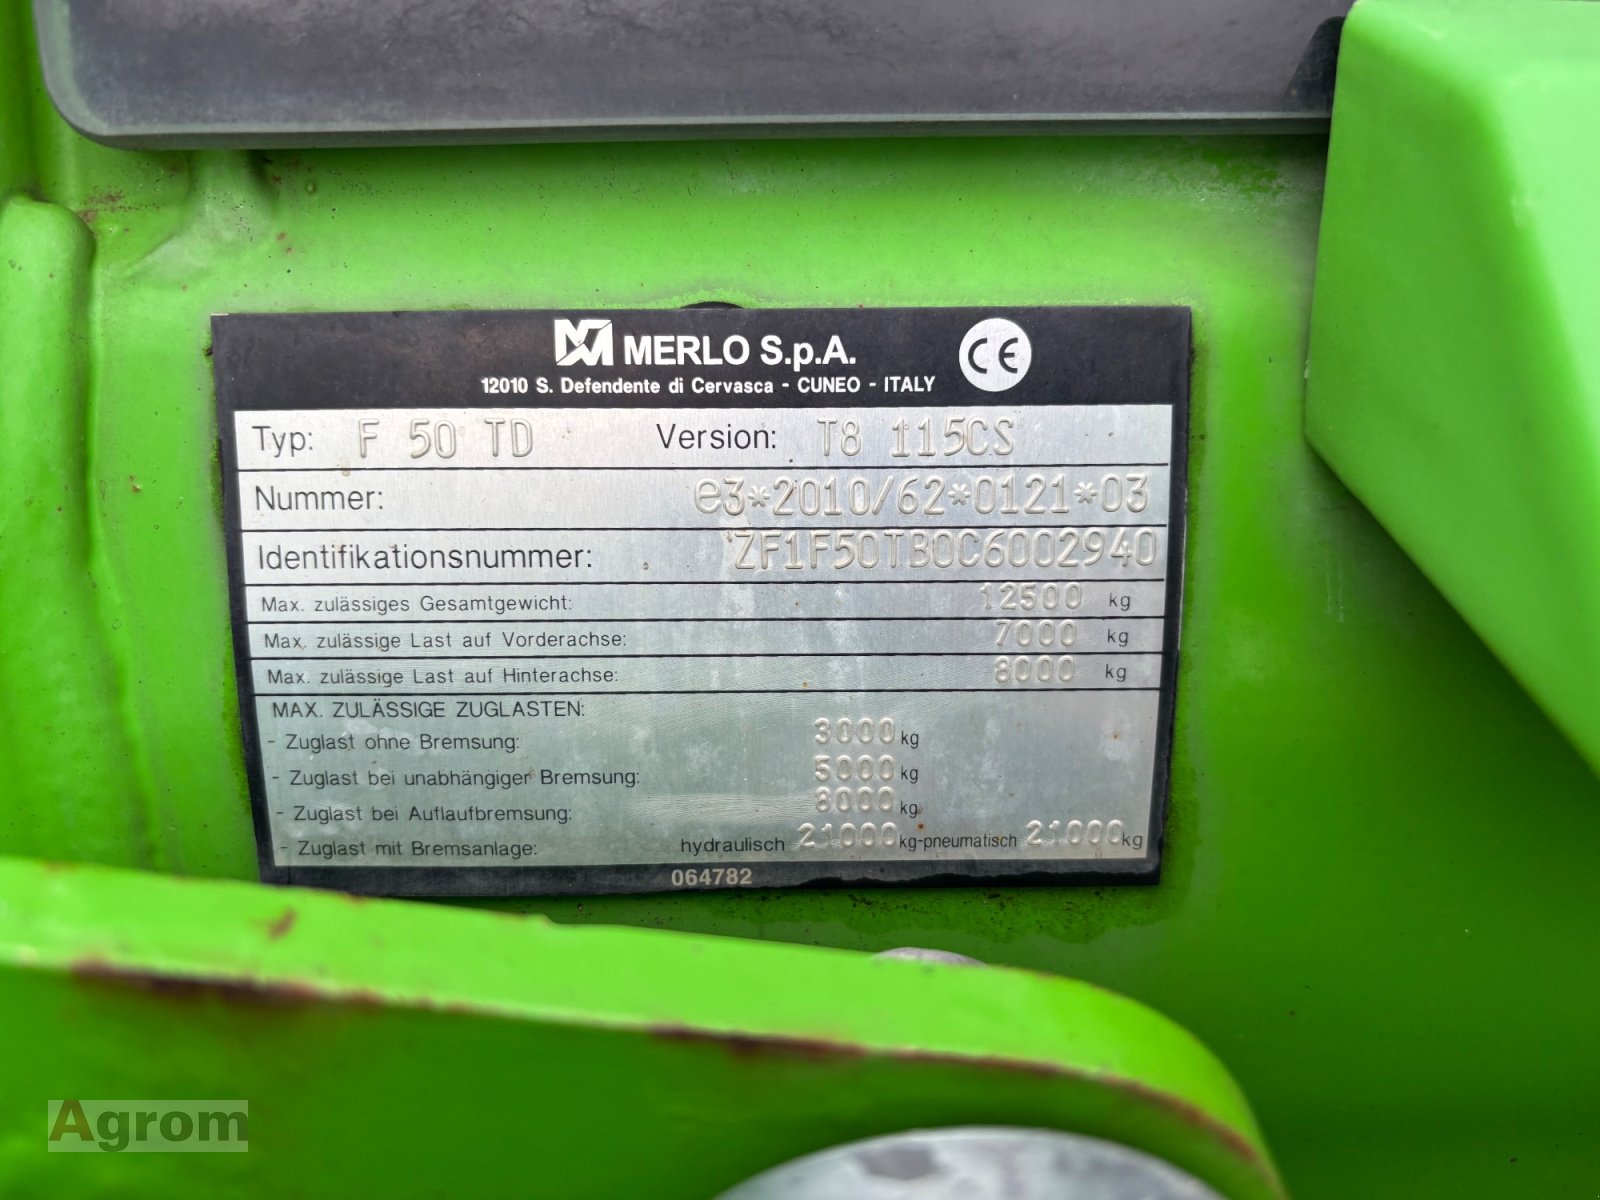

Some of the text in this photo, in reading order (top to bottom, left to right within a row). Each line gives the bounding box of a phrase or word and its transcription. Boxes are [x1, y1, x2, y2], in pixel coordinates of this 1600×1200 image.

[623, 335, 857, 372] MERLO S.p.A.
[968, 337, 1019, 374] CE
[481, 378, 529, 394] 12010
[536, 378, 555, 394] S.
[561, 377, 660, 394] Defendente
[668, 376, 684, 394] di
[692, 377, 774, 394] Cervasca
[797, 376, 861, 393] CUNEO
[884, 376, 936, 393] ITALY
[252, 416, 534, 459] Typ: F 50 TD
[656, 416, 1016, 459] Version: T8 115CS
[255, 486, 384, 511] Nummer:
[258, 543, 592, 571] Identifikationsnummer:
[262, 581, 1131, 615] Max. zulässiges Gesamtgewicht: 12500 kg
[264, 619, 1129, 652] Max. zulässige Last auf Vorderachse: 7000 kg
[267, 655, 1127, 687] Max. zulässige Last auf Hinterachse: 8000 kg
[272, 698, 585, 719] MAX. ZULÄSSIGE ZUGLASTEN:
[286, 733, 355, 753] Zuglast
[365, 733, 411, 750] ohne
[420, 733, 520, 753] Bremsung:
[814, 717, 896, 746] 3000
[900, 730, 920, 749] kg
[290, 769, 359, 789] Zuglast
[368, 769, 396, 786] bei
[404, 769, 532, 790] unabhängiger
[541, 769, 640, 789] Bremsung:
[814, 755, 896, 782] 5000
[900, 765, 919, 784] kg
[294, 805, 363, 825] Zuglast
[372, 805, 399, 821] bei
[409, 805, 573, 825] Auflaufbremsung:
[814, 786, 896, 813] 8000
[900, 801, 919, 819] kg
[298, 841, 367, 860] Zuglast
[375, 841, 402, 856] mit
[411, 841, 537, 860] Bremsanlage:
[681, 836, 785, 855] hydraulisch
[797, 821, 898, 849] 21000
[1026, 819, 1123, 847] 21000
[1121, 833, 1144, 851] kg
[671, 867, 753, 886] 064782
